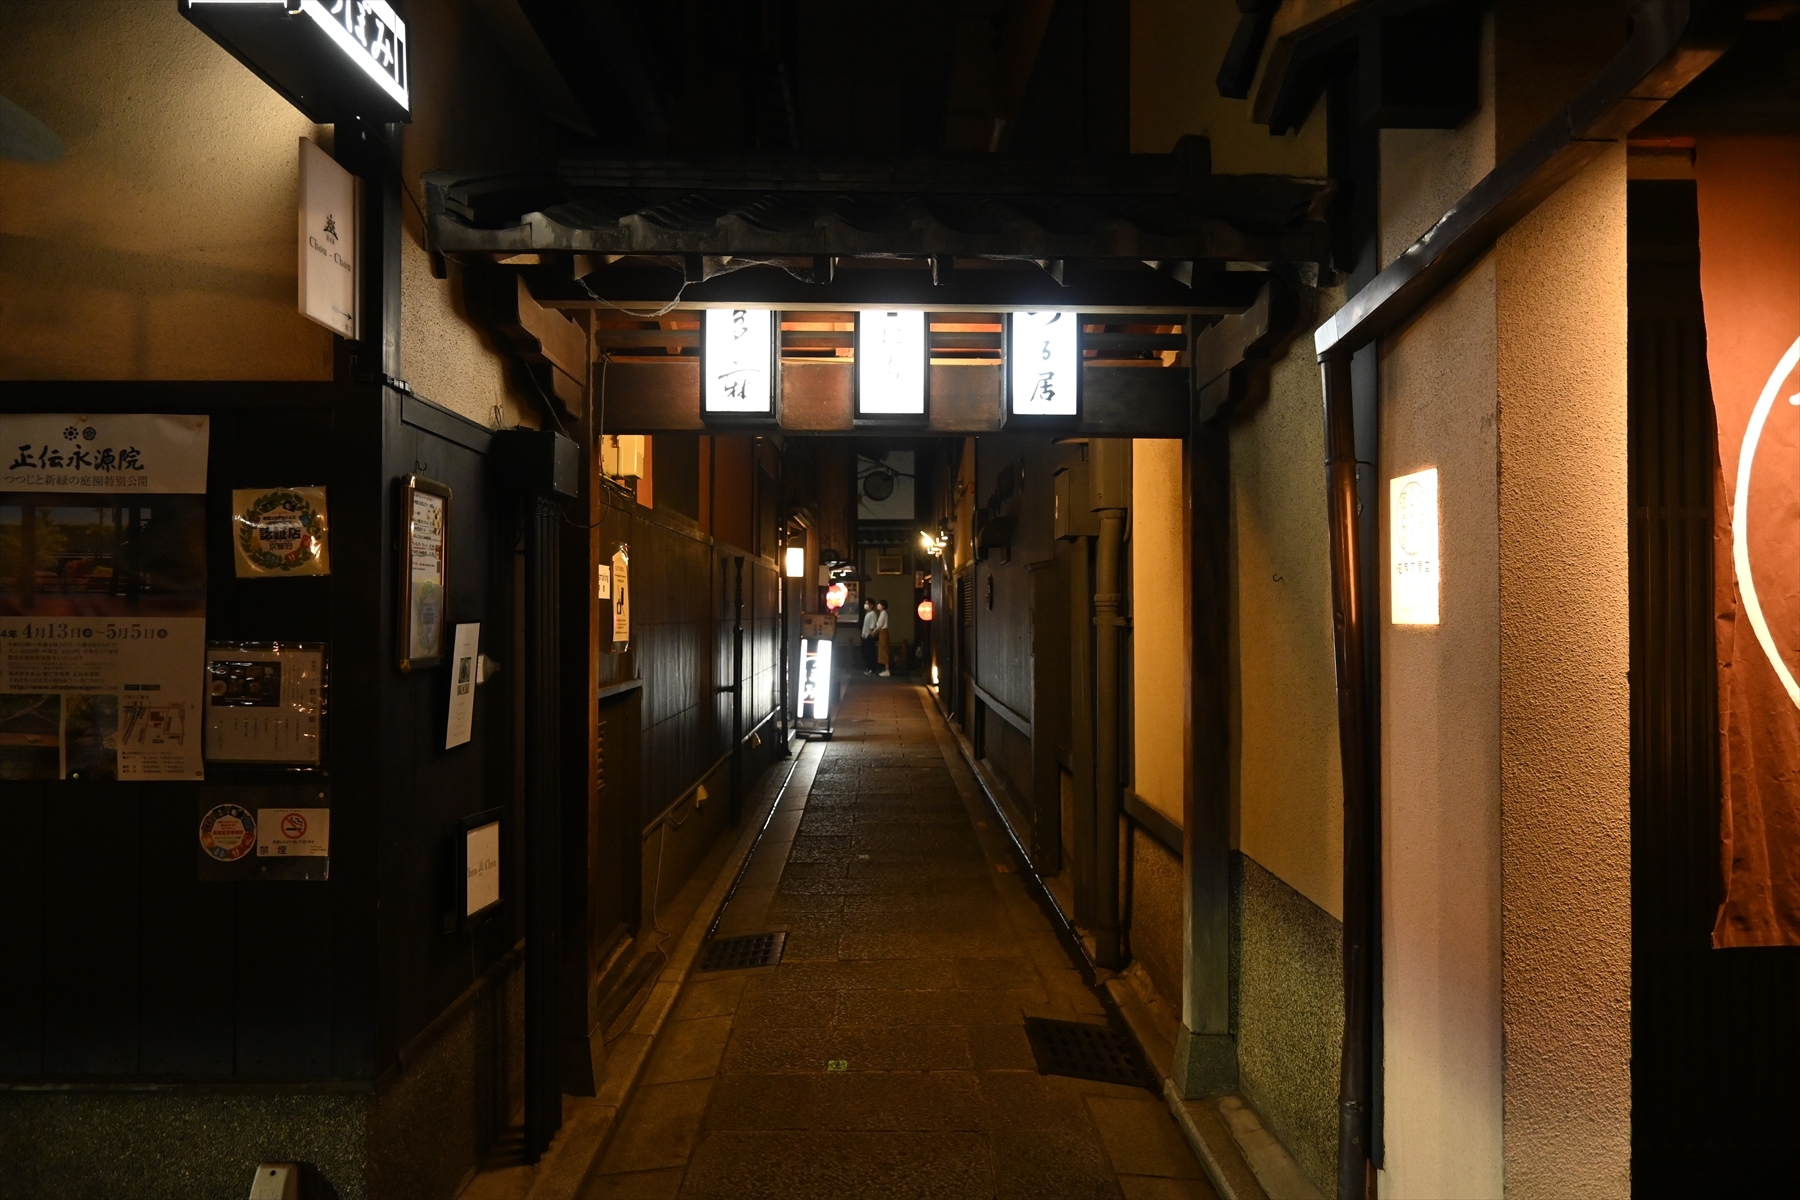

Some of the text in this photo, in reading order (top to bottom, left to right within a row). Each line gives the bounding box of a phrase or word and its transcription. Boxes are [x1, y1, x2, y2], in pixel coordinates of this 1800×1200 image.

[9, 444, 145, 473] 正伝永源院
[4, 475, 149, 488] つつじと新緑の庭園特別公開
